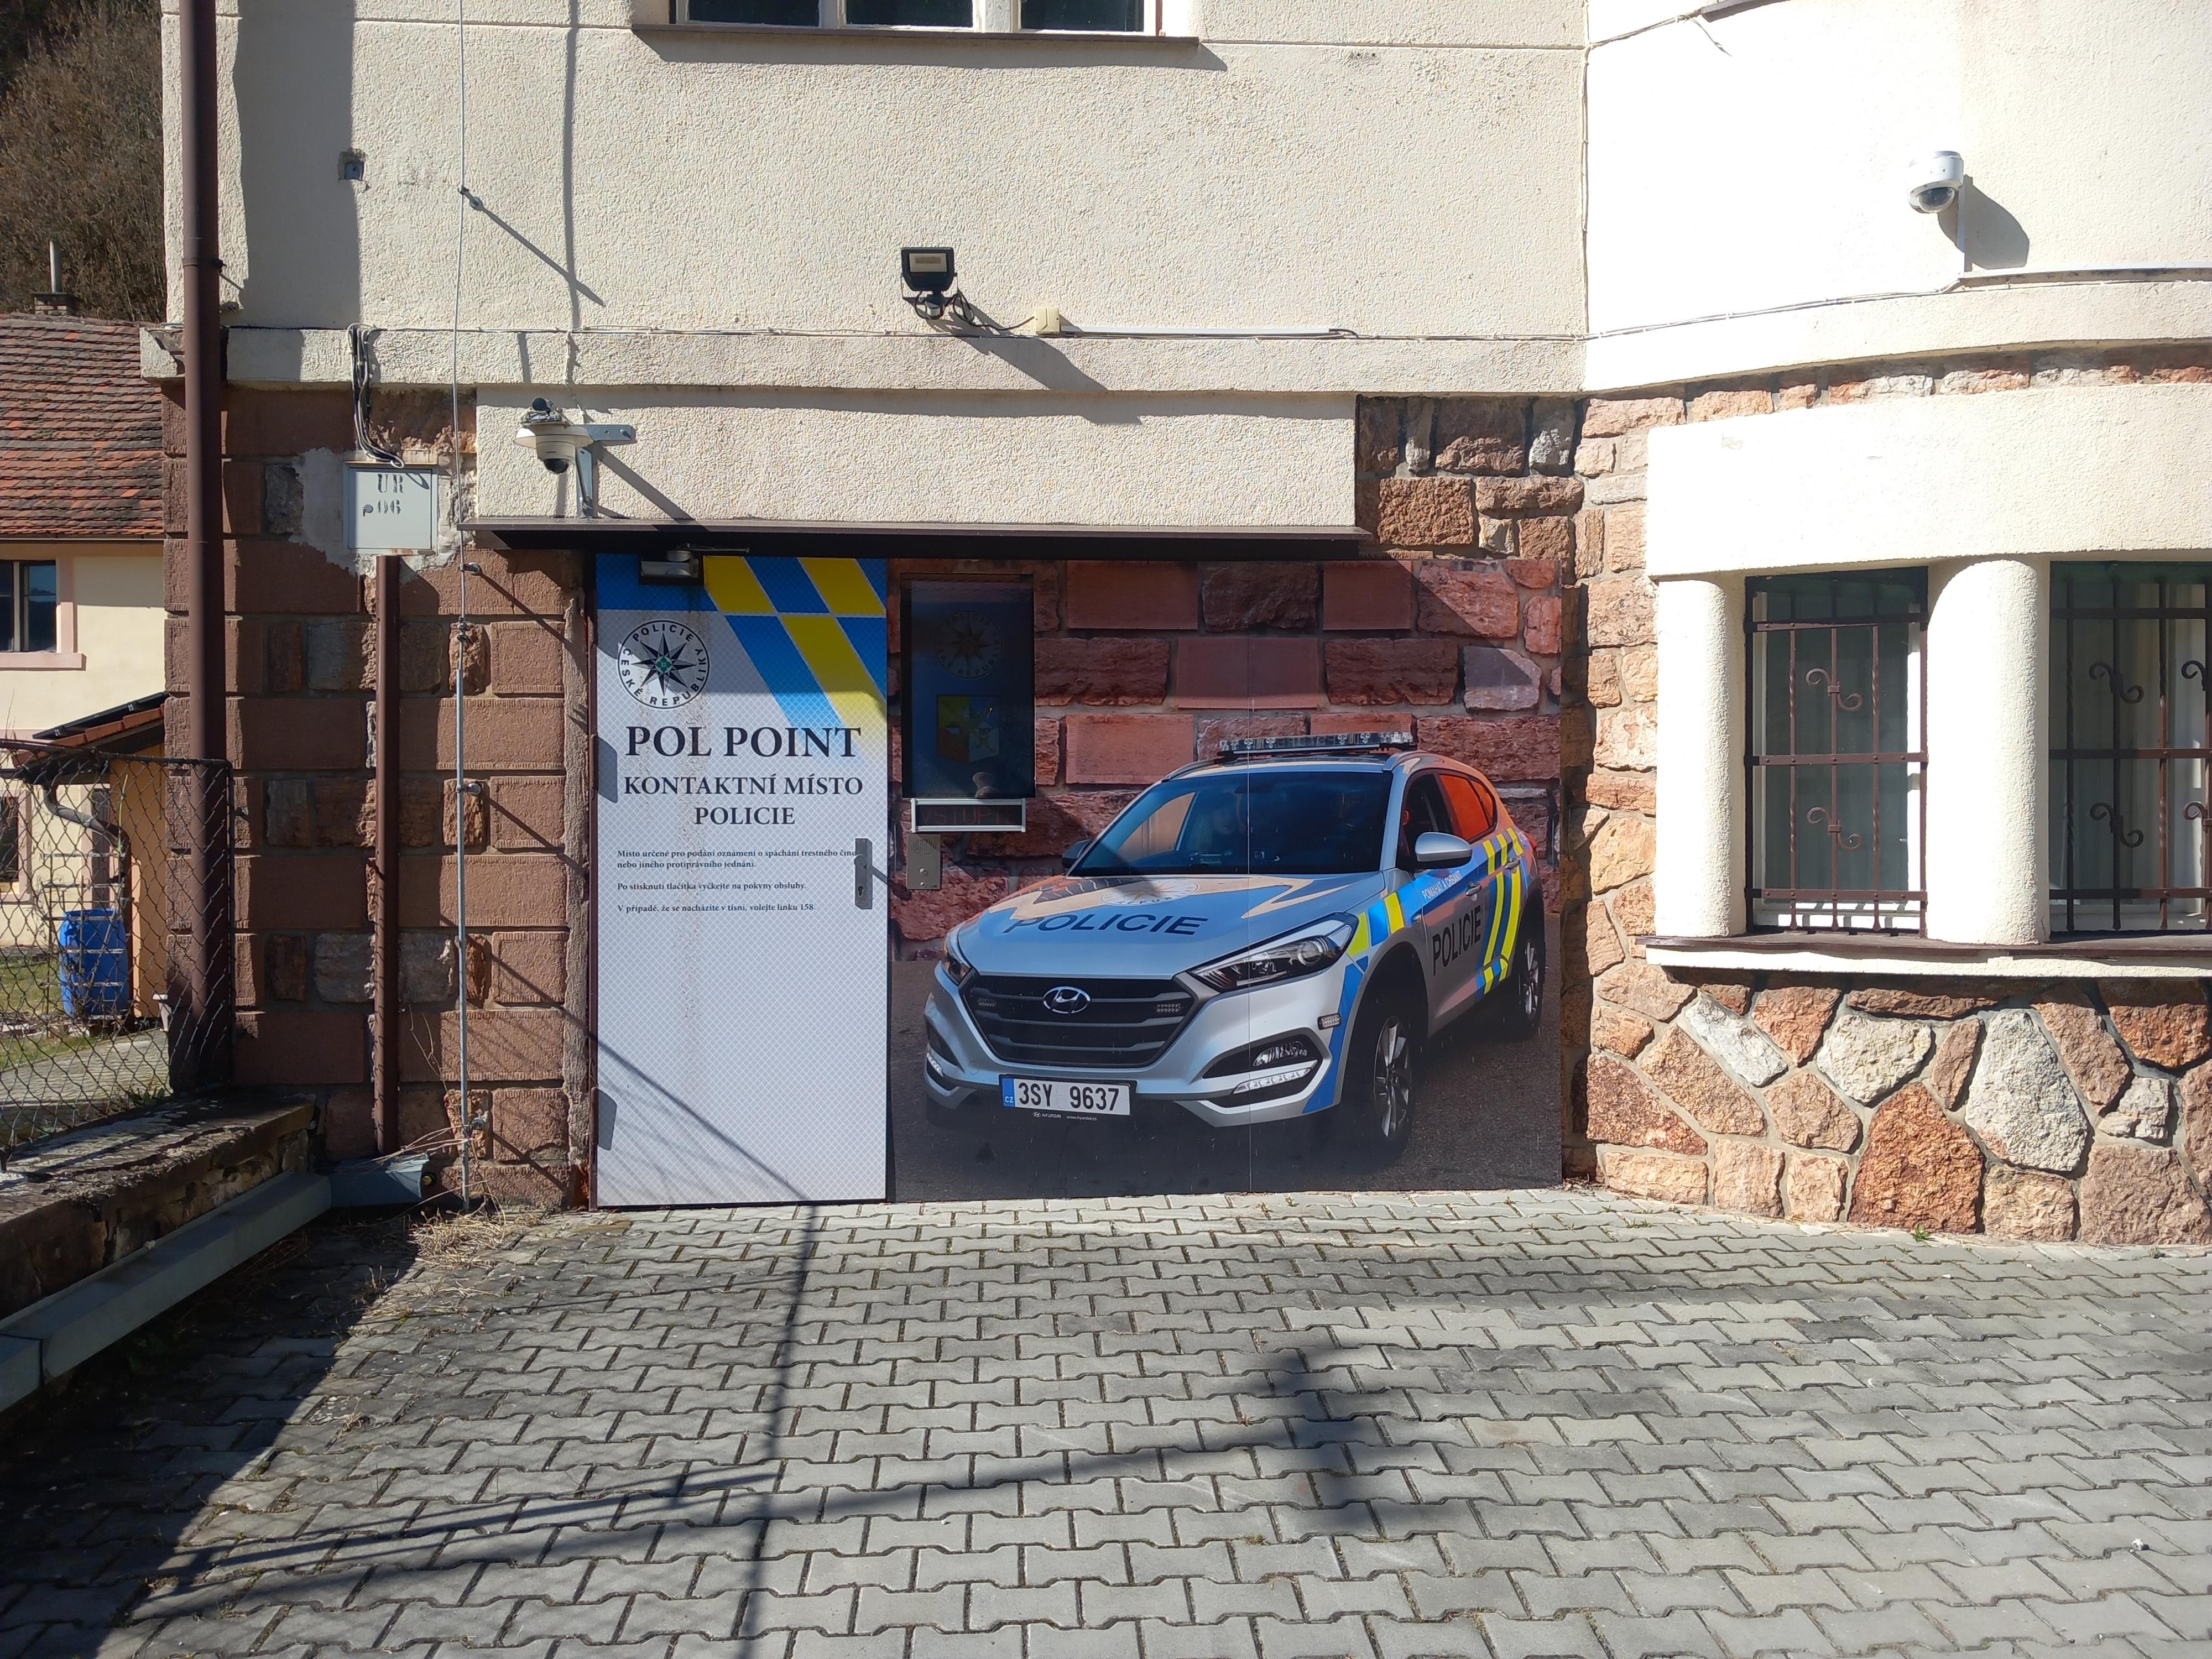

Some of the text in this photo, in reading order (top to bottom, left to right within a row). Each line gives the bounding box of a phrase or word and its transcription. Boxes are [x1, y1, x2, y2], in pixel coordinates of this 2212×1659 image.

[378, 474, 404, 493] UR
[633, 623, 693, 642] POLICIE
[621, 648, 644, 697] ČESKÉ
[649, 648, 706, 706] REPUBLIKY
[625, 725, 862, 758] POL POINT
[624, 773, 863, 795] KONTAKTNÍ MÍSTO
[694, 806, 796, 825] POLICIE
[687, 849, 715, 858] podání
[765, 849, 799, 858] spáchání
[639, 861, 664, 870] jiného
[666, 860, 722, 869] protiprávního
[724, 860, 756, 869] jednání.
[698, 882, 729, 891] vyčkejte
[744, 882, 773, 890] pokyny
[774, 881, 806, 890] obsluhy.
[682, 904, 719, 912] nacházíte
[750, 904, 775, 912] volejte
[1003, 914, 1208, 935] POLICIE
[1432, 905, 1481, 977] POLICIE
[1004, 1082, 1119, 1112] CZ 3SY 9637
